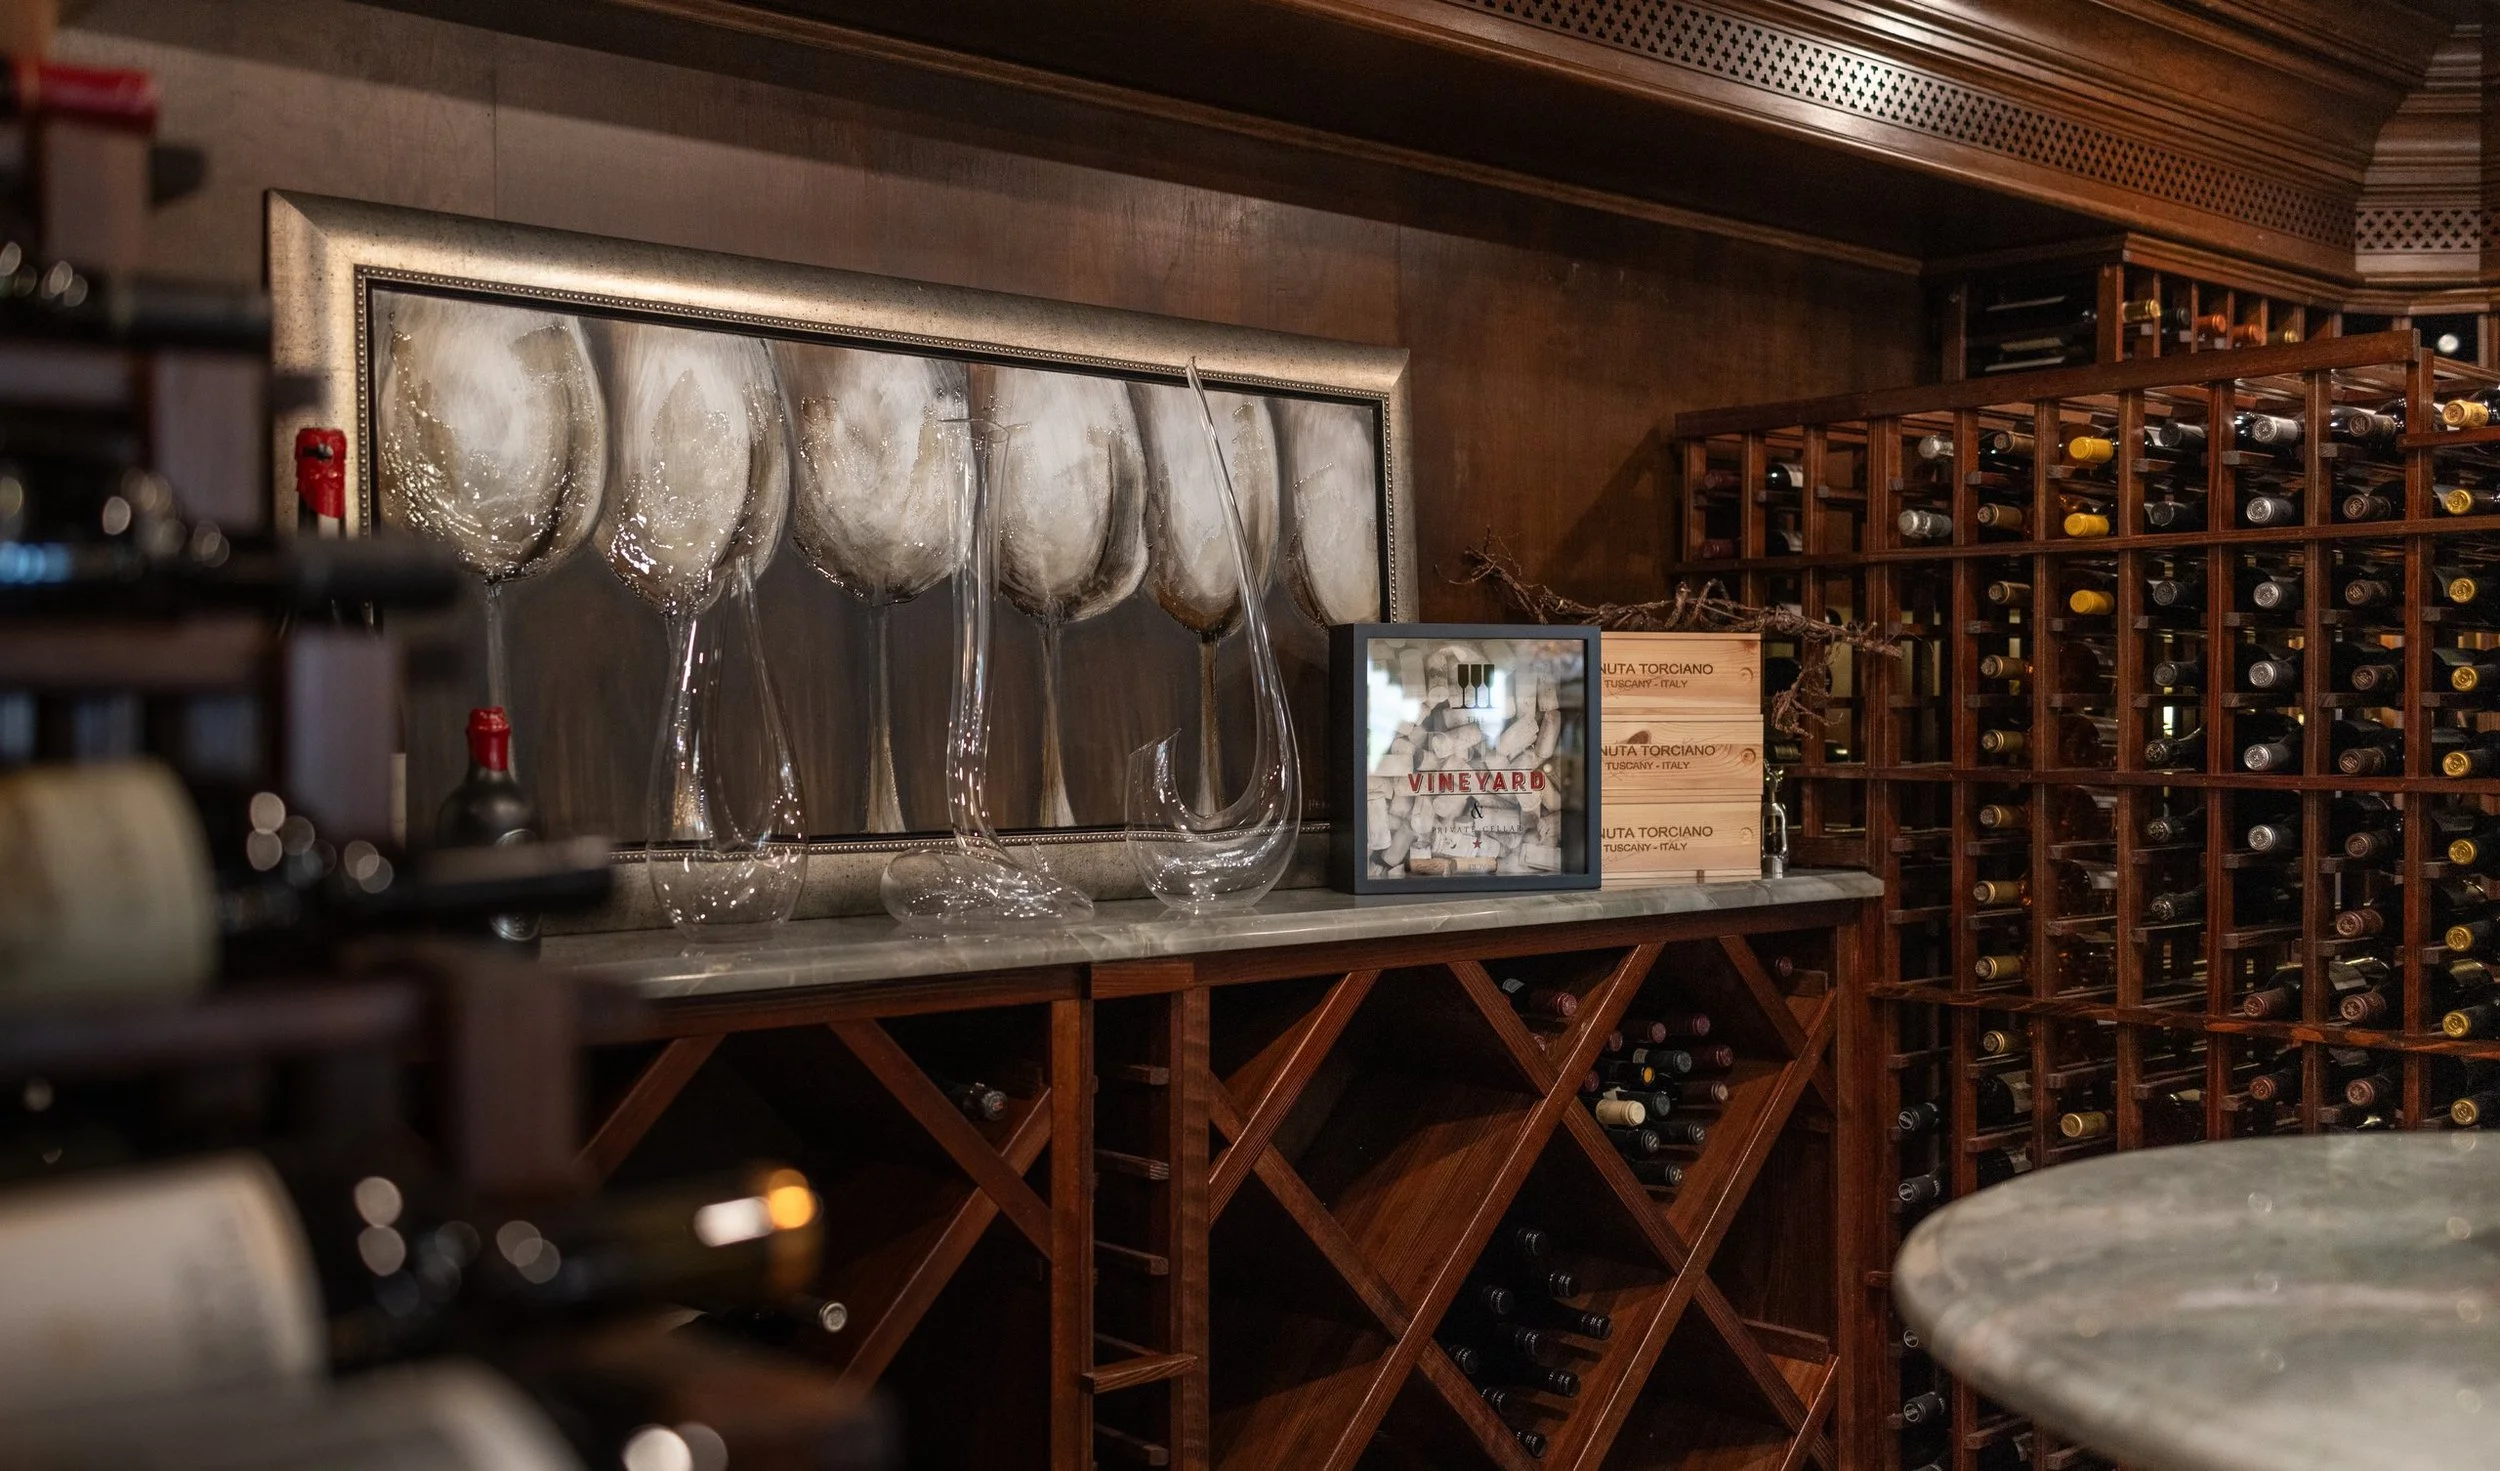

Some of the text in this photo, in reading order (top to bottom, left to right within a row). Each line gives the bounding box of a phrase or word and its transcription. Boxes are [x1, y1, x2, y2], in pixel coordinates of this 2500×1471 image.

[1638, 663, 1714, 675] TORCIANO
[1604, 679, 1652, 688] TUSCANY
[1660, 679, 1688, 688] ITALY
[1640, 745, 1716, 757] TORCIANO
[1606, 761, 1654, 770] TUSCANY
[1662, 761, 1690, 770] ITALY
[1408, 770, 1546, 793] VINEYARD
[1471, 801, 1483, 819] &
[1432, 824, 1523, 834] PRIVATE CELLAR
[1638, 826, 1713, 838] TORCIANO
[1603, 843, 1651, 852] TUSCANY
[1659, 842, 1688, 851] ITALY
